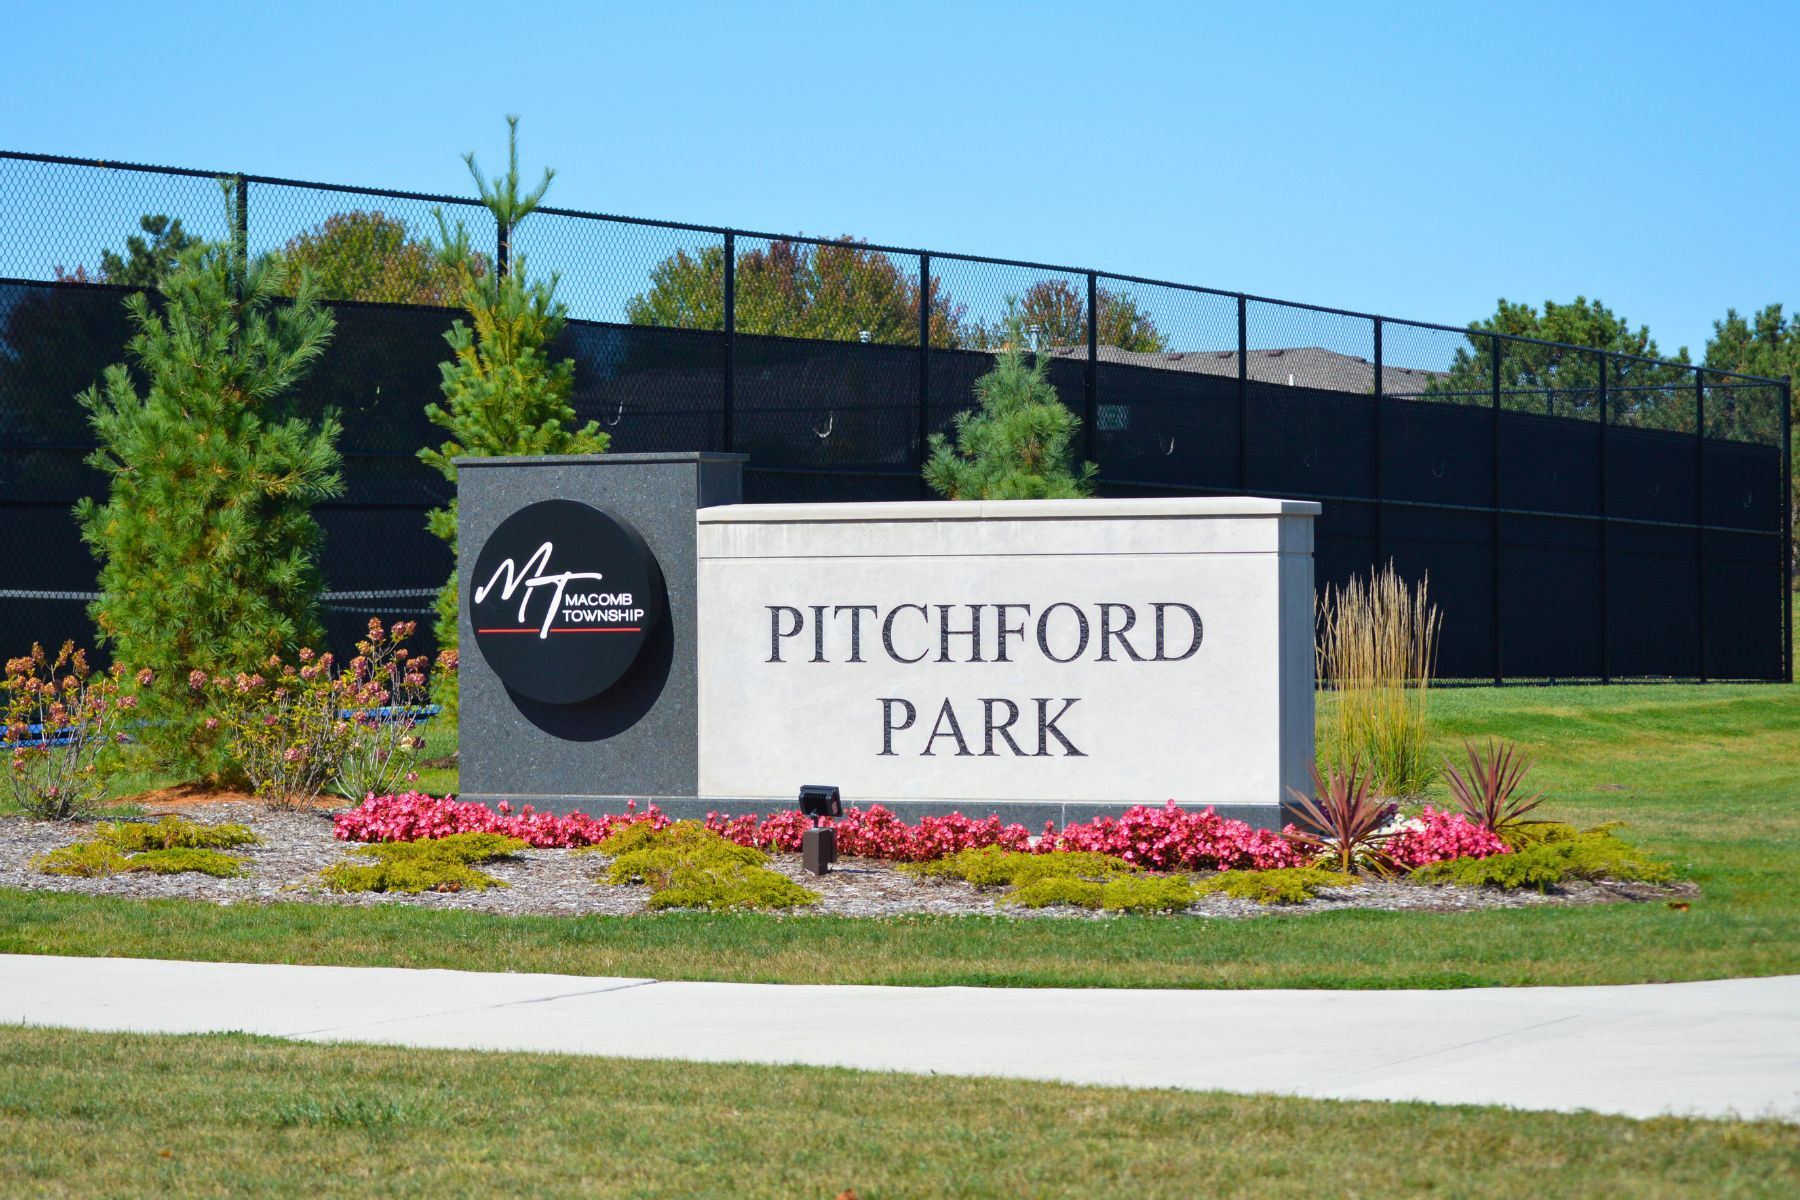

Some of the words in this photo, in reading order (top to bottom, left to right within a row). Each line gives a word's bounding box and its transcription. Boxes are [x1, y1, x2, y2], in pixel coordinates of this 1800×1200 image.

[562, 608, 645, 622] TOWNSHIP
[565, 593, 633, 606] MACOMB
[765, 602, 1204, 664] PITCHFORD
[876, 697, 1089, 757] PARK
